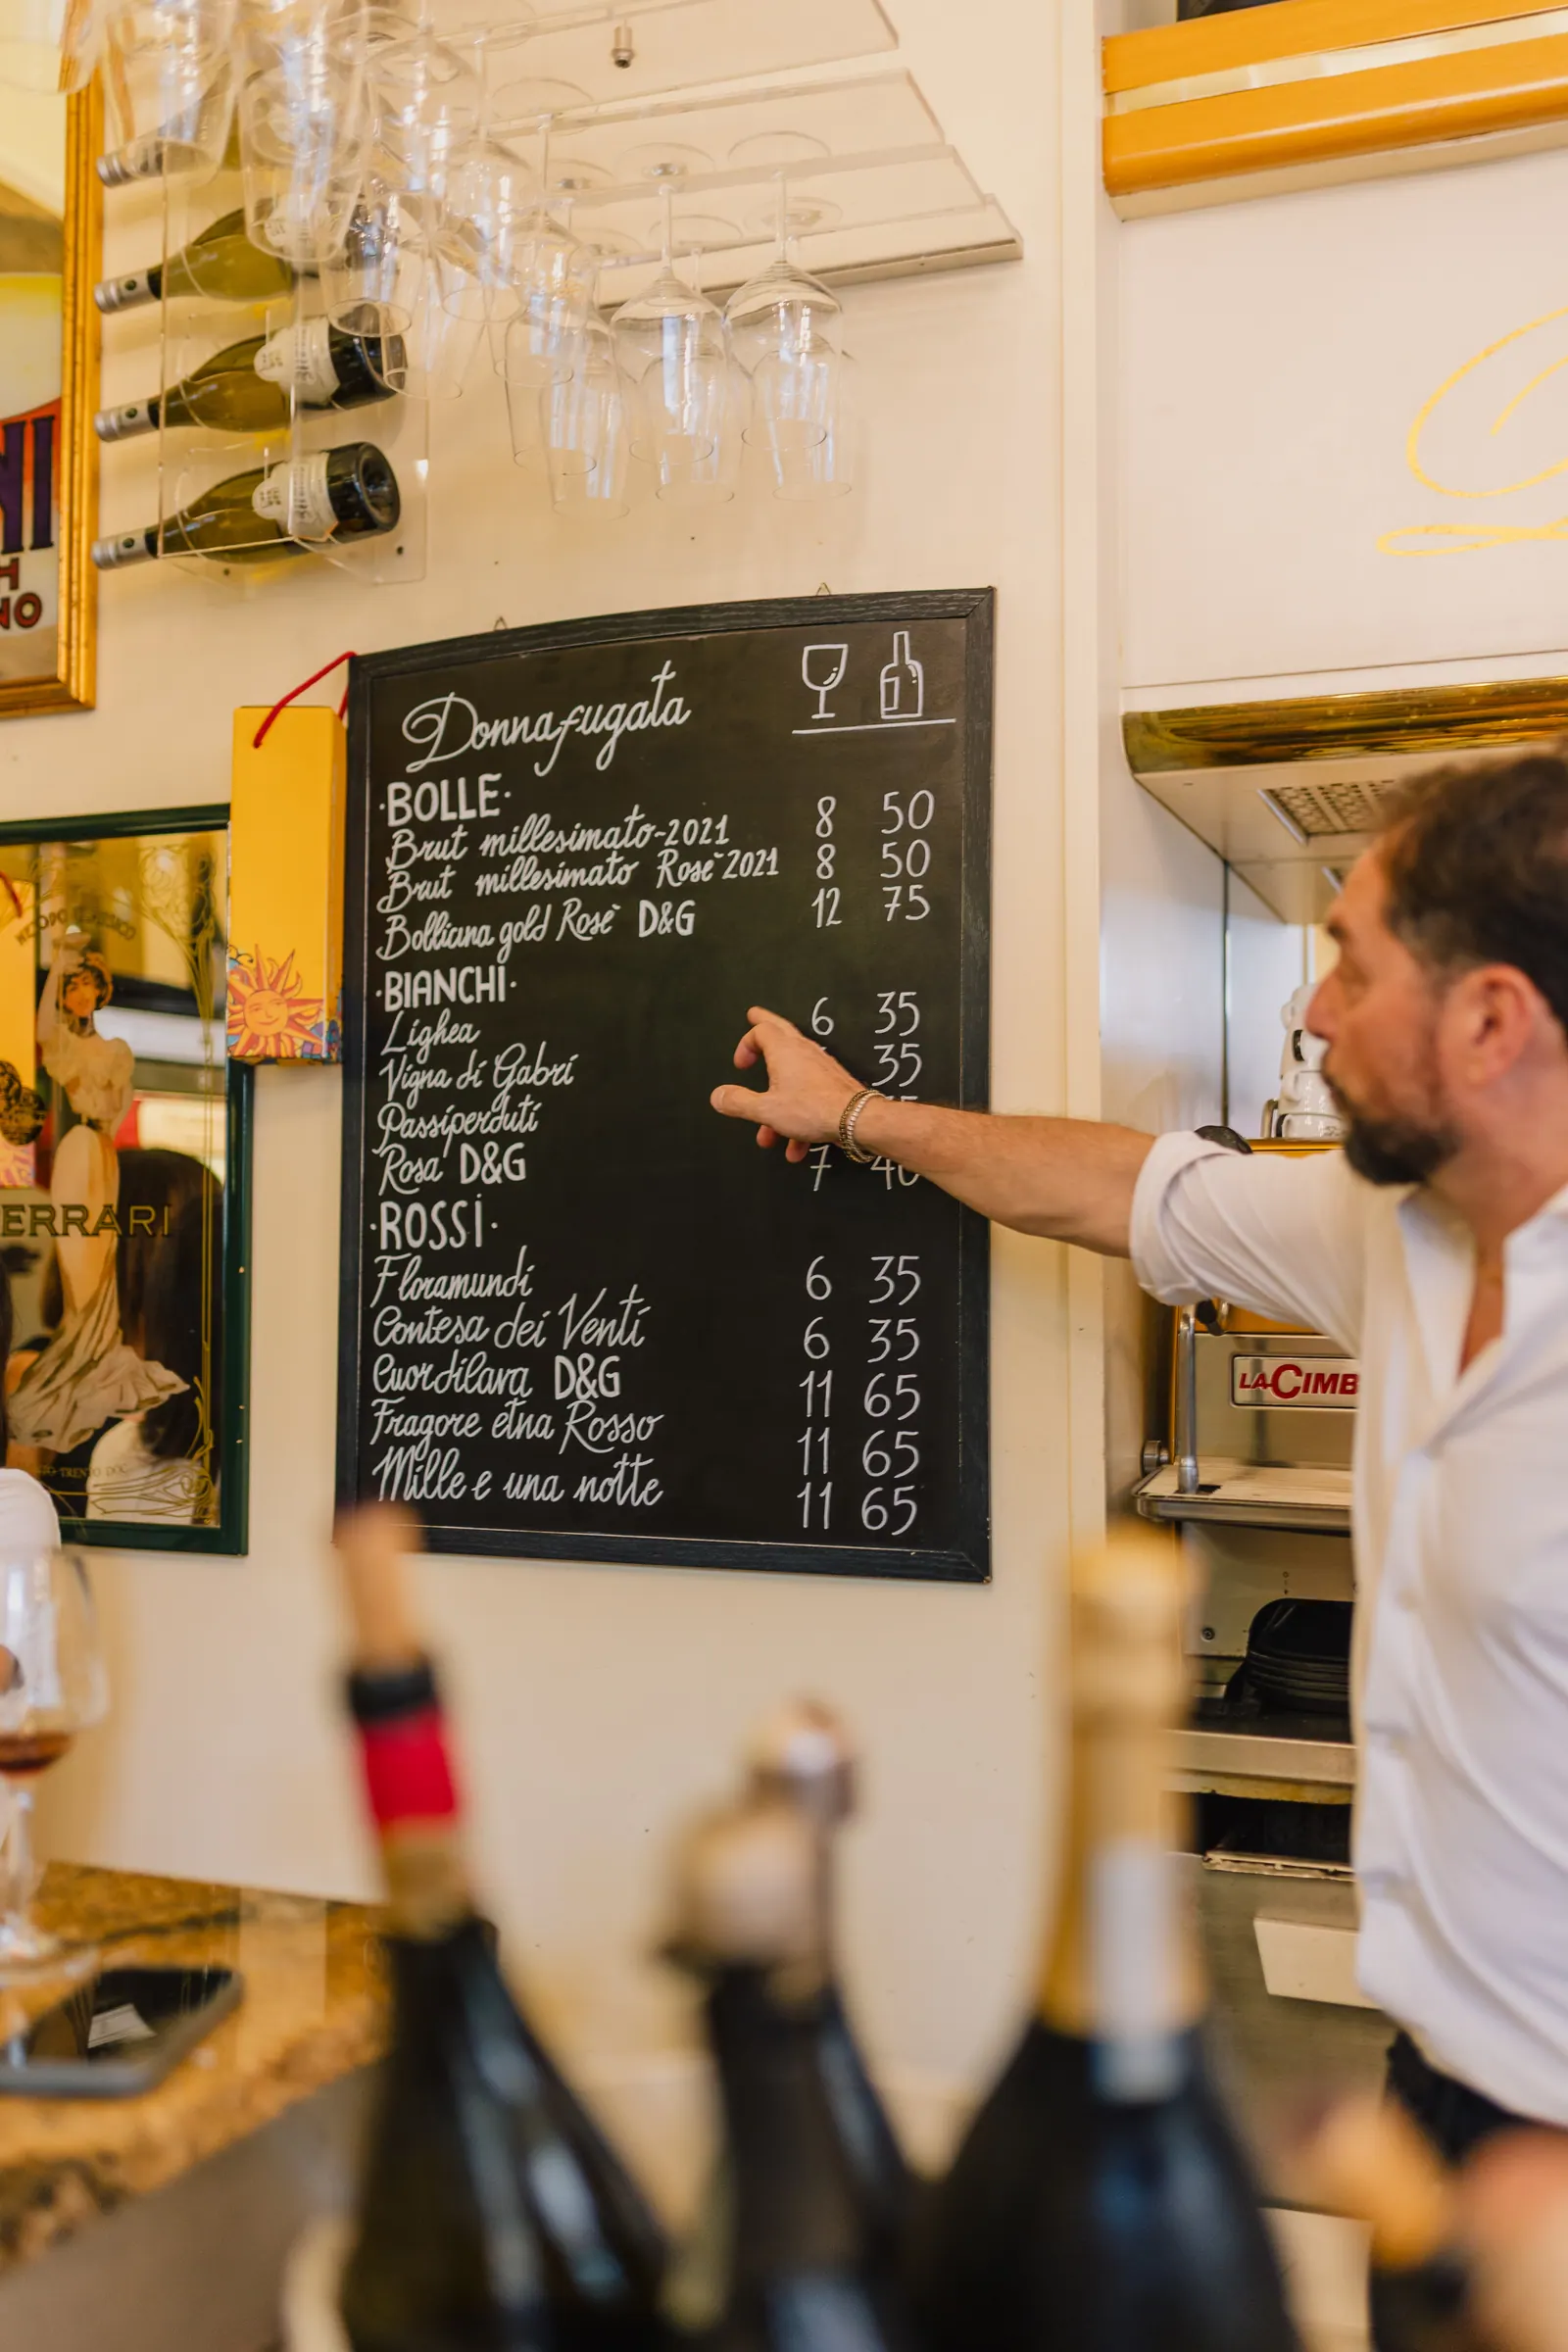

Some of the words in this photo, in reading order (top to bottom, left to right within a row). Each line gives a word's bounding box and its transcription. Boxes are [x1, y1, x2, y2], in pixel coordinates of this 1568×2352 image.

[402, 660, 692, 777] Donnafugata
[815, 796, 837, 838] 8
[881, 790, 935, 834] 50
[385, 823, 468, 875] Brut
[815, 844, 836, 880] 8
[880, 839, 931, 878] 50
[376, 864, 457, 913] Brut
[475, 850, 640, 897] millesimato
[721, 847, 779, 880] 2021
[882, 884, 931, 921] 75
[497, 904, 552, 964] gold
[638, 900, 696, 938] D&G
[810, 887, 843, 928] 12
[380, 1007, 481, 1064] Lighea
[811, 997, 834, 1036] 6
[874, 991, 920, 1037] 35
[378, 1053, 453, 1110] Vigna
[456, 1049, 488, 1090] di
[871, 1043, 923, 1088] 35
[371, 1094, 542, 1158] Passiperduti
[378, 1143, 444, 1196] Rosa
[460, 1141, 526, 1185] D&G
[808, 1144, 832, 1192] 7
[369, 1245, 535, 1308] Floramundi
[806, 1255, 832, 1300] 6
[868, 1255, 921, 1305] 35
[372, 1305, 490, 1348] Contesa
[493, 1301, 551, 1348] dei
[558, 1284, 652, 1350] Venti
[803, 1316, 830, 1360] 6
[866, 1317, 920, 1363] 35
[372, 1348, 533, 1396] Cuordilava
[555, 1352, 621, 1400] D&G
[799, 1369, 833, 1418] 11
[863, 1372, 921, 1421] 65
[369, 1396, 483, 1461] Fragore
[491, 1396, 555, 1440] etna
[559, 1399, 665, 1455] Rosso
[797, 1427, 830, 1476] 11
[371, 1445, 467, 1501] Mille
[471, 1470, 493, 1501] e
[503, 1472, 565, 1502] una
[573, 1452, 664, 1507] notte
[861, 1429, 920, 1479] 65
[796, 1481, 833, 1530] 11
[860, 1486, 918, 1536] 65
